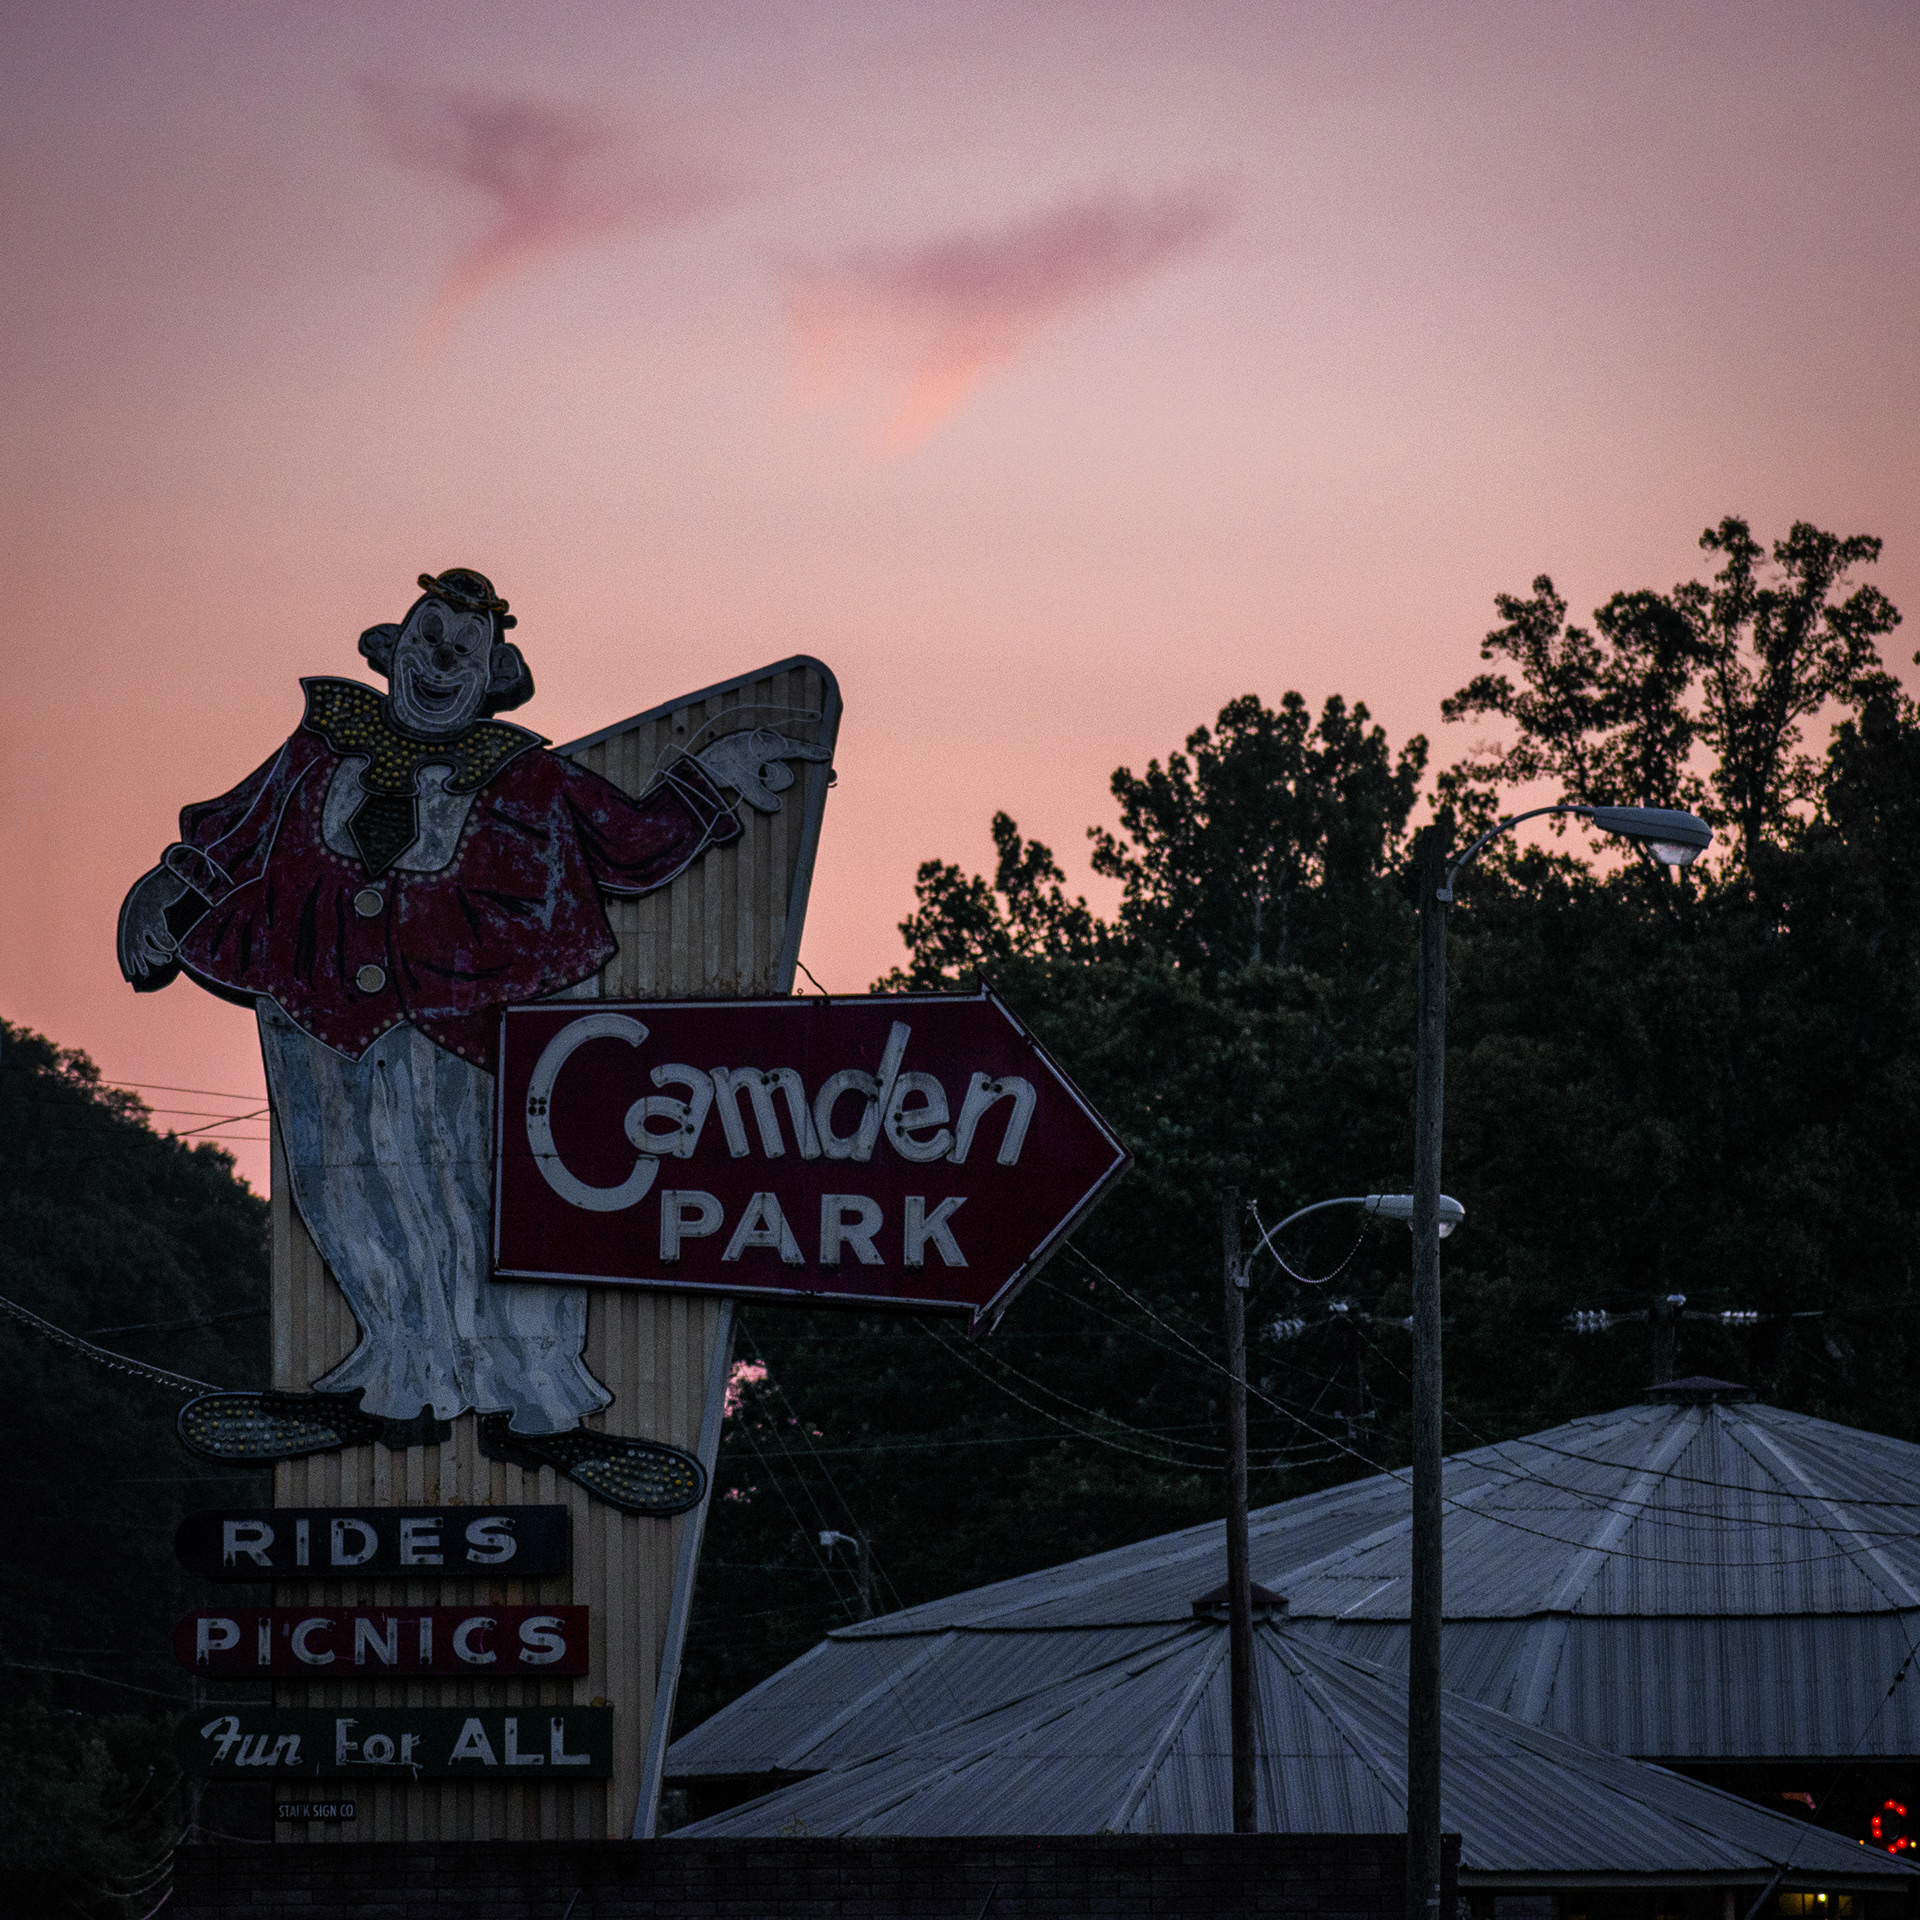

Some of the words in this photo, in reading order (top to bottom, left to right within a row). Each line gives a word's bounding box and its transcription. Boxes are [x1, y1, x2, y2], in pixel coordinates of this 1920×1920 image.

[525, 1012, 1037, 1212] Camden
[659, 1189, 969, 1268] PARK
[222, 1516, 518, 1567] RIDES
[196, 1616, 567, 1665] PICNICS
[200, 1715, 302, 1767] Fun
[335, 1718, 427, 1768] For
[448, 1717, 591, 1766] ALL
[312, 1804, 338, 1818] SIGN
